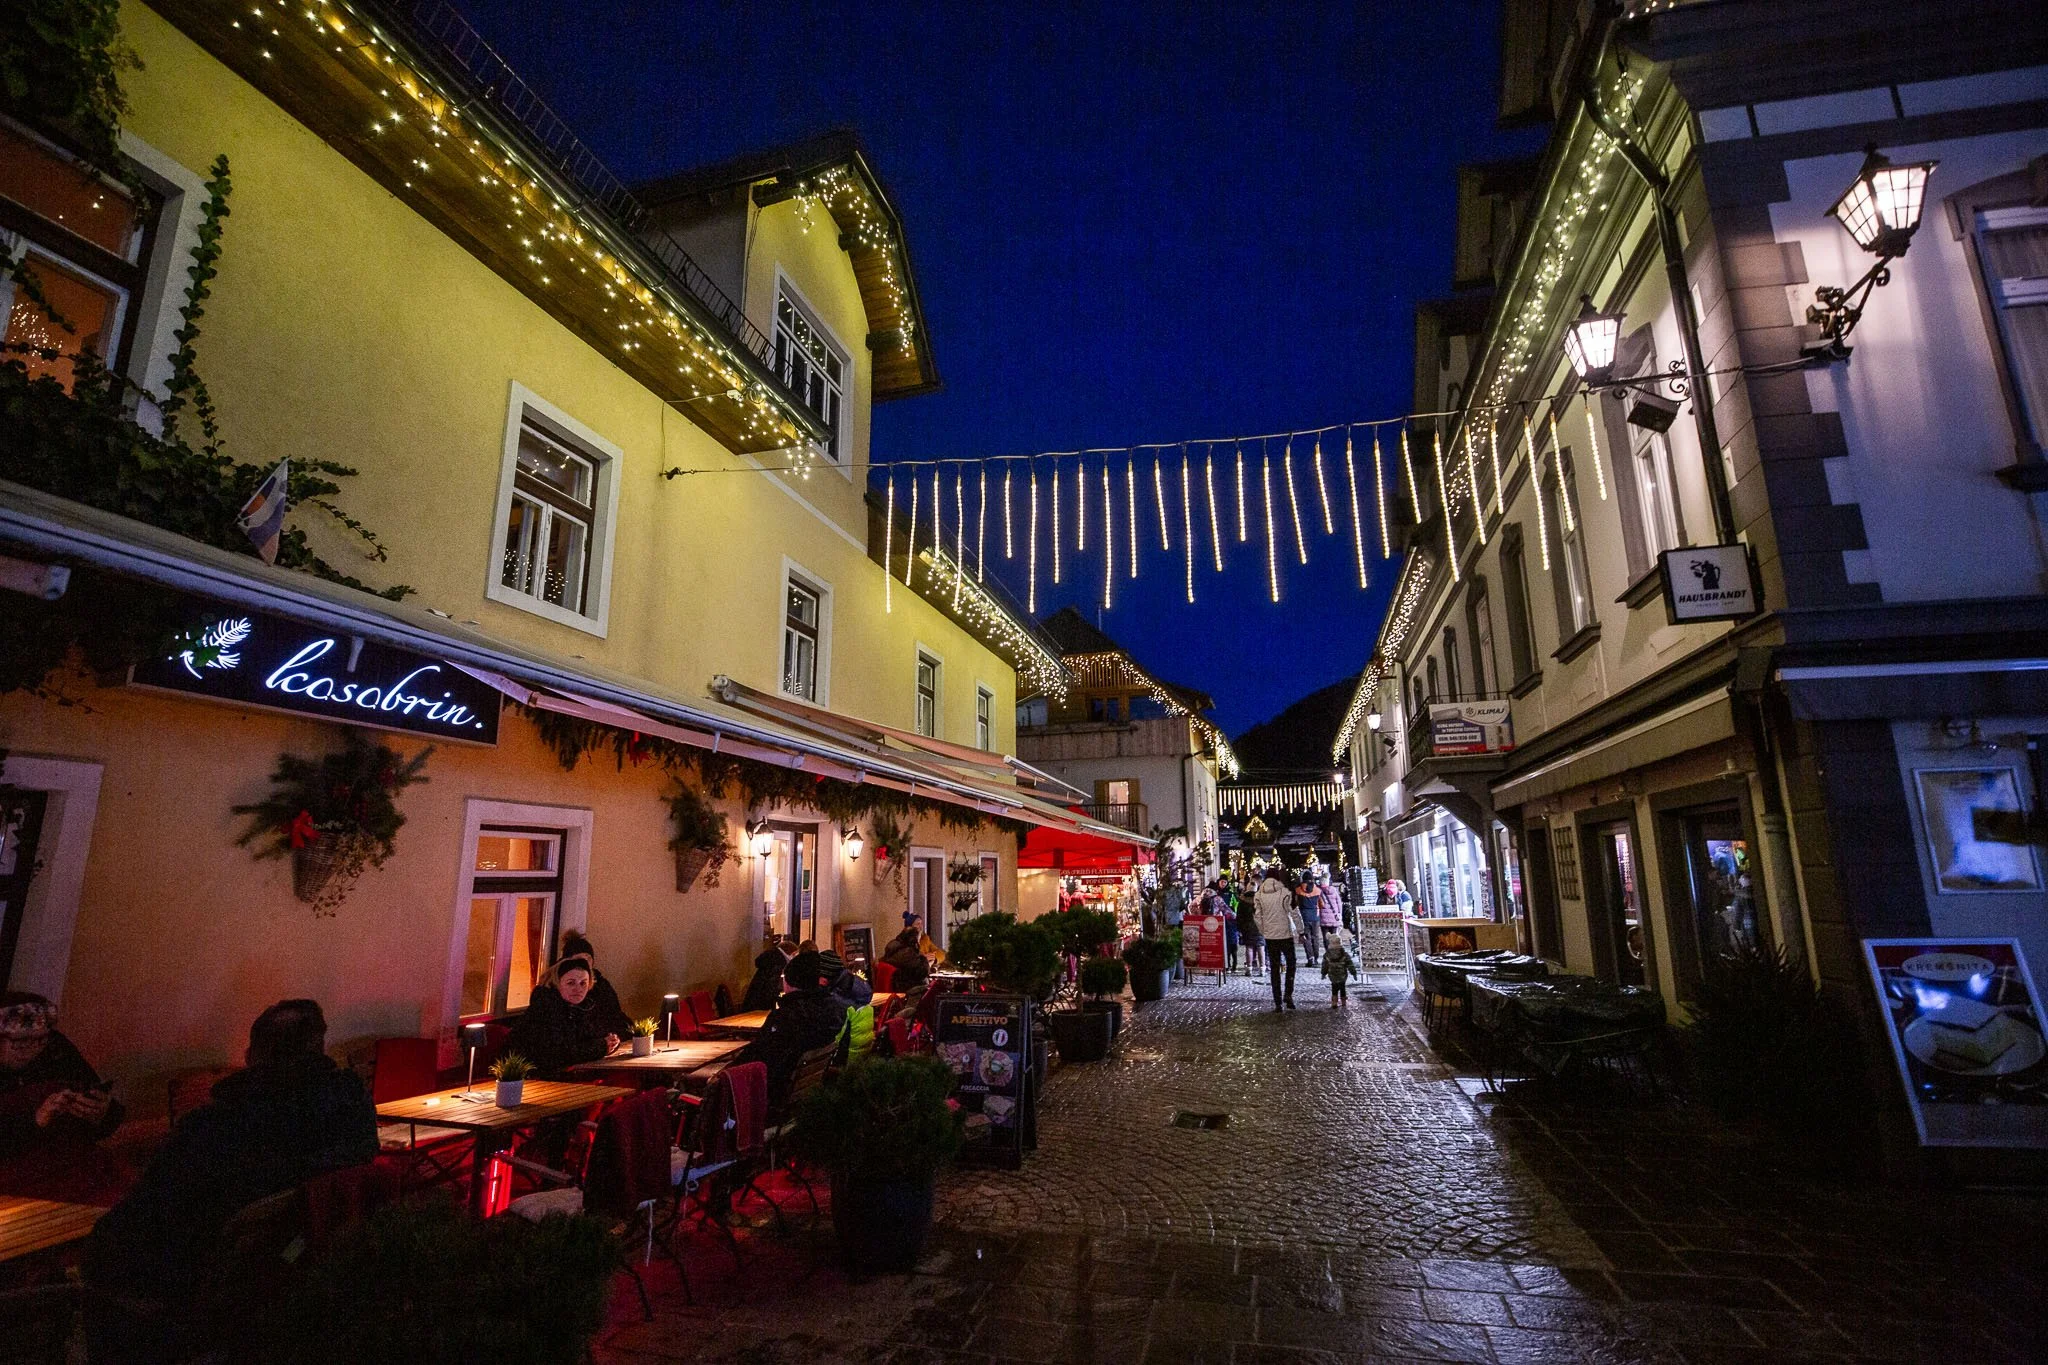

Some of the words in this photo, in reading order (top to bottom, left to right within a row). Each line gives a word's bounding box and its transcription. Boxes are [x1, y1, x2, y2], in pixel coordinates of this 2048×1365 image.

[1679, 590, 1747, 603] HAUSBRANDT
[1477, 707, 1505, 716] KLIMAJ
[951, 1015, 1009, 1026] APERITIVO
